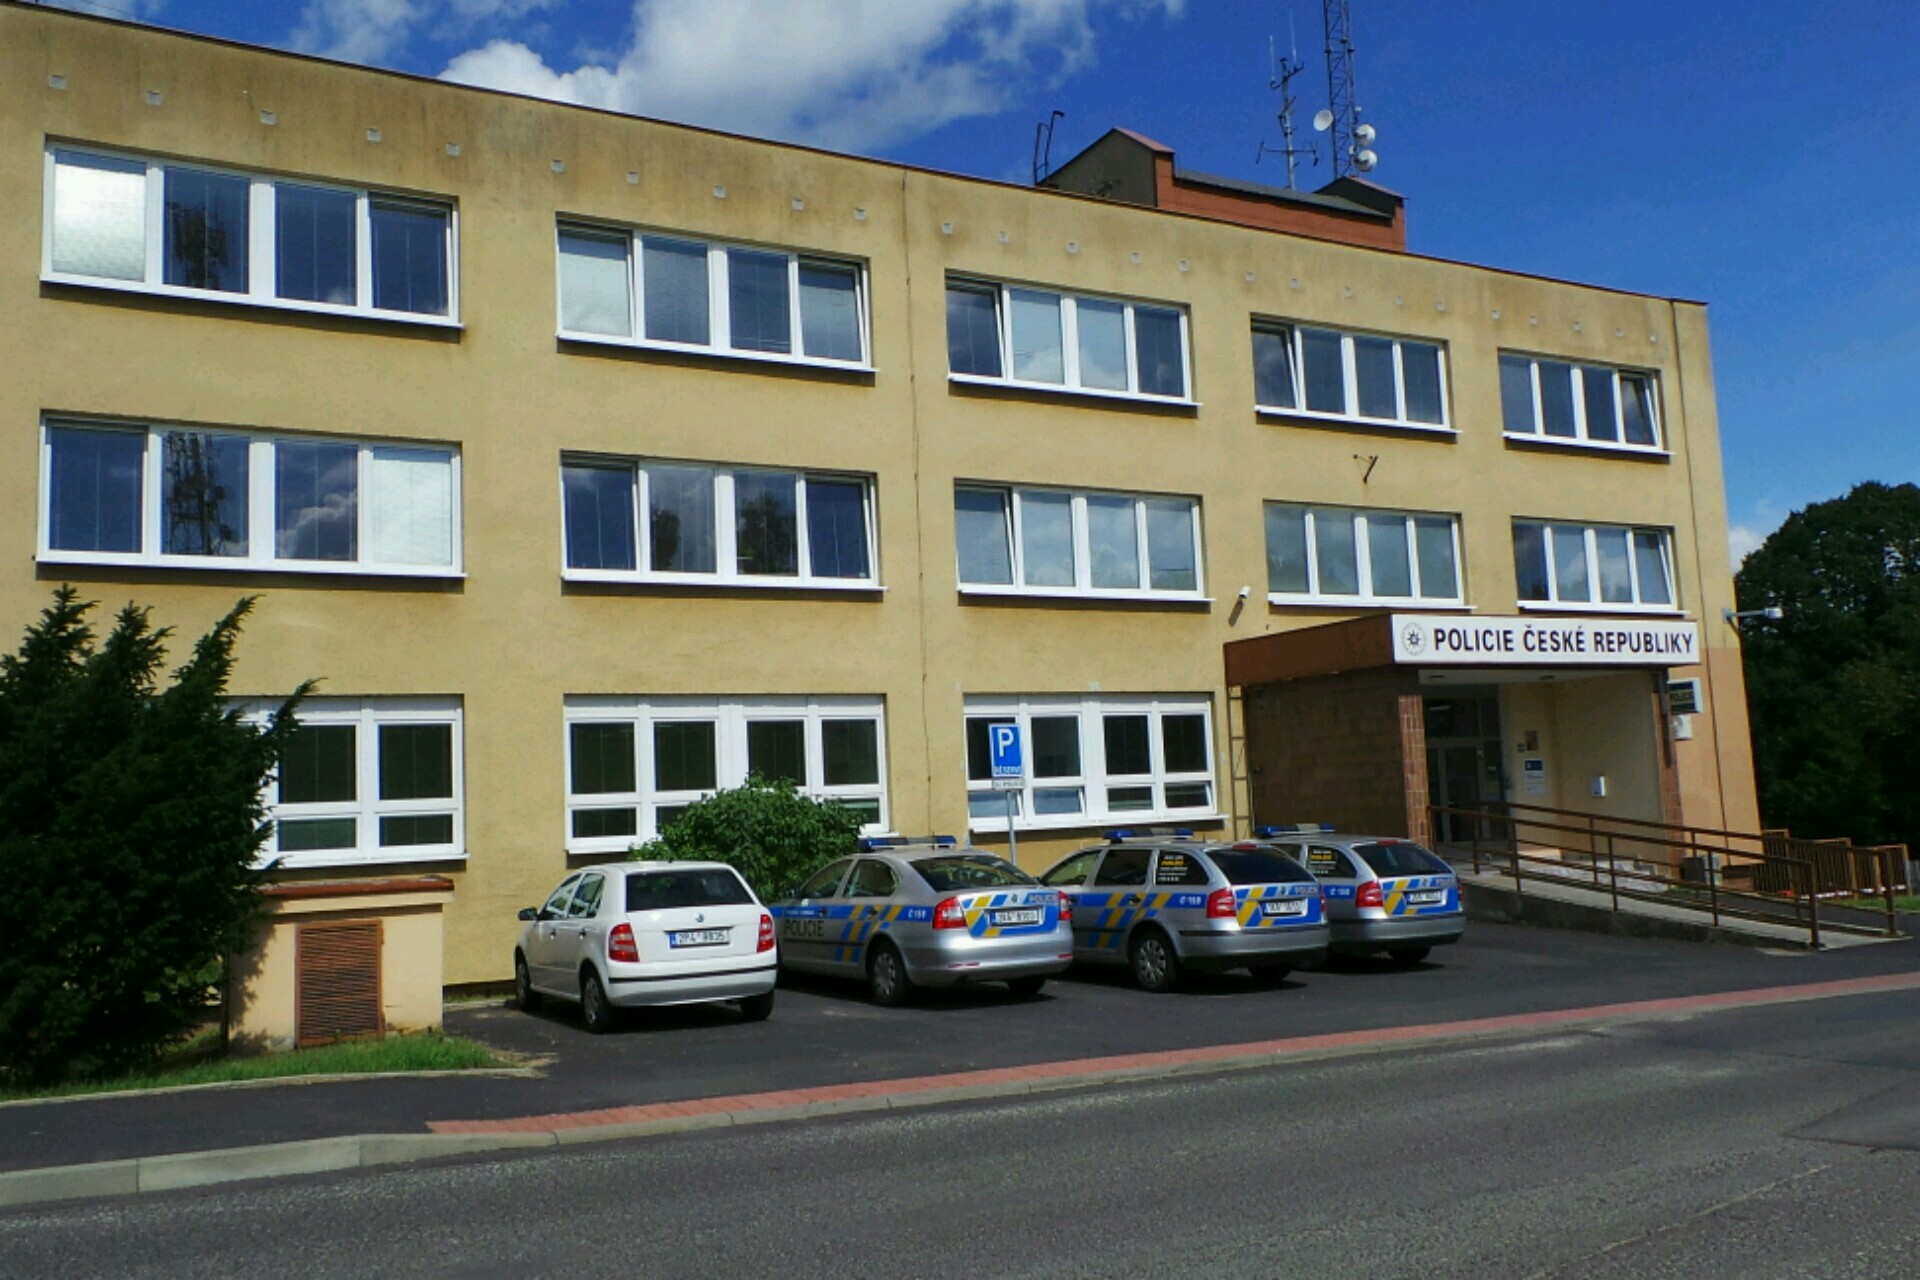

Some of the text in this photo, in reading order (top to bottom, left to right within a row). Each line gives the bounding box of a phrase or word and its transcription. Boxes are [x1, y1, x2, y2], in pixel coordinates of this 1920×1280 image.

[1433, 624, 1693, 654] POLICIE ČESKÉ REPUBLIKY
[997, 728, 1014, 757] P
[784, 919, 824, 937] POLICIE
